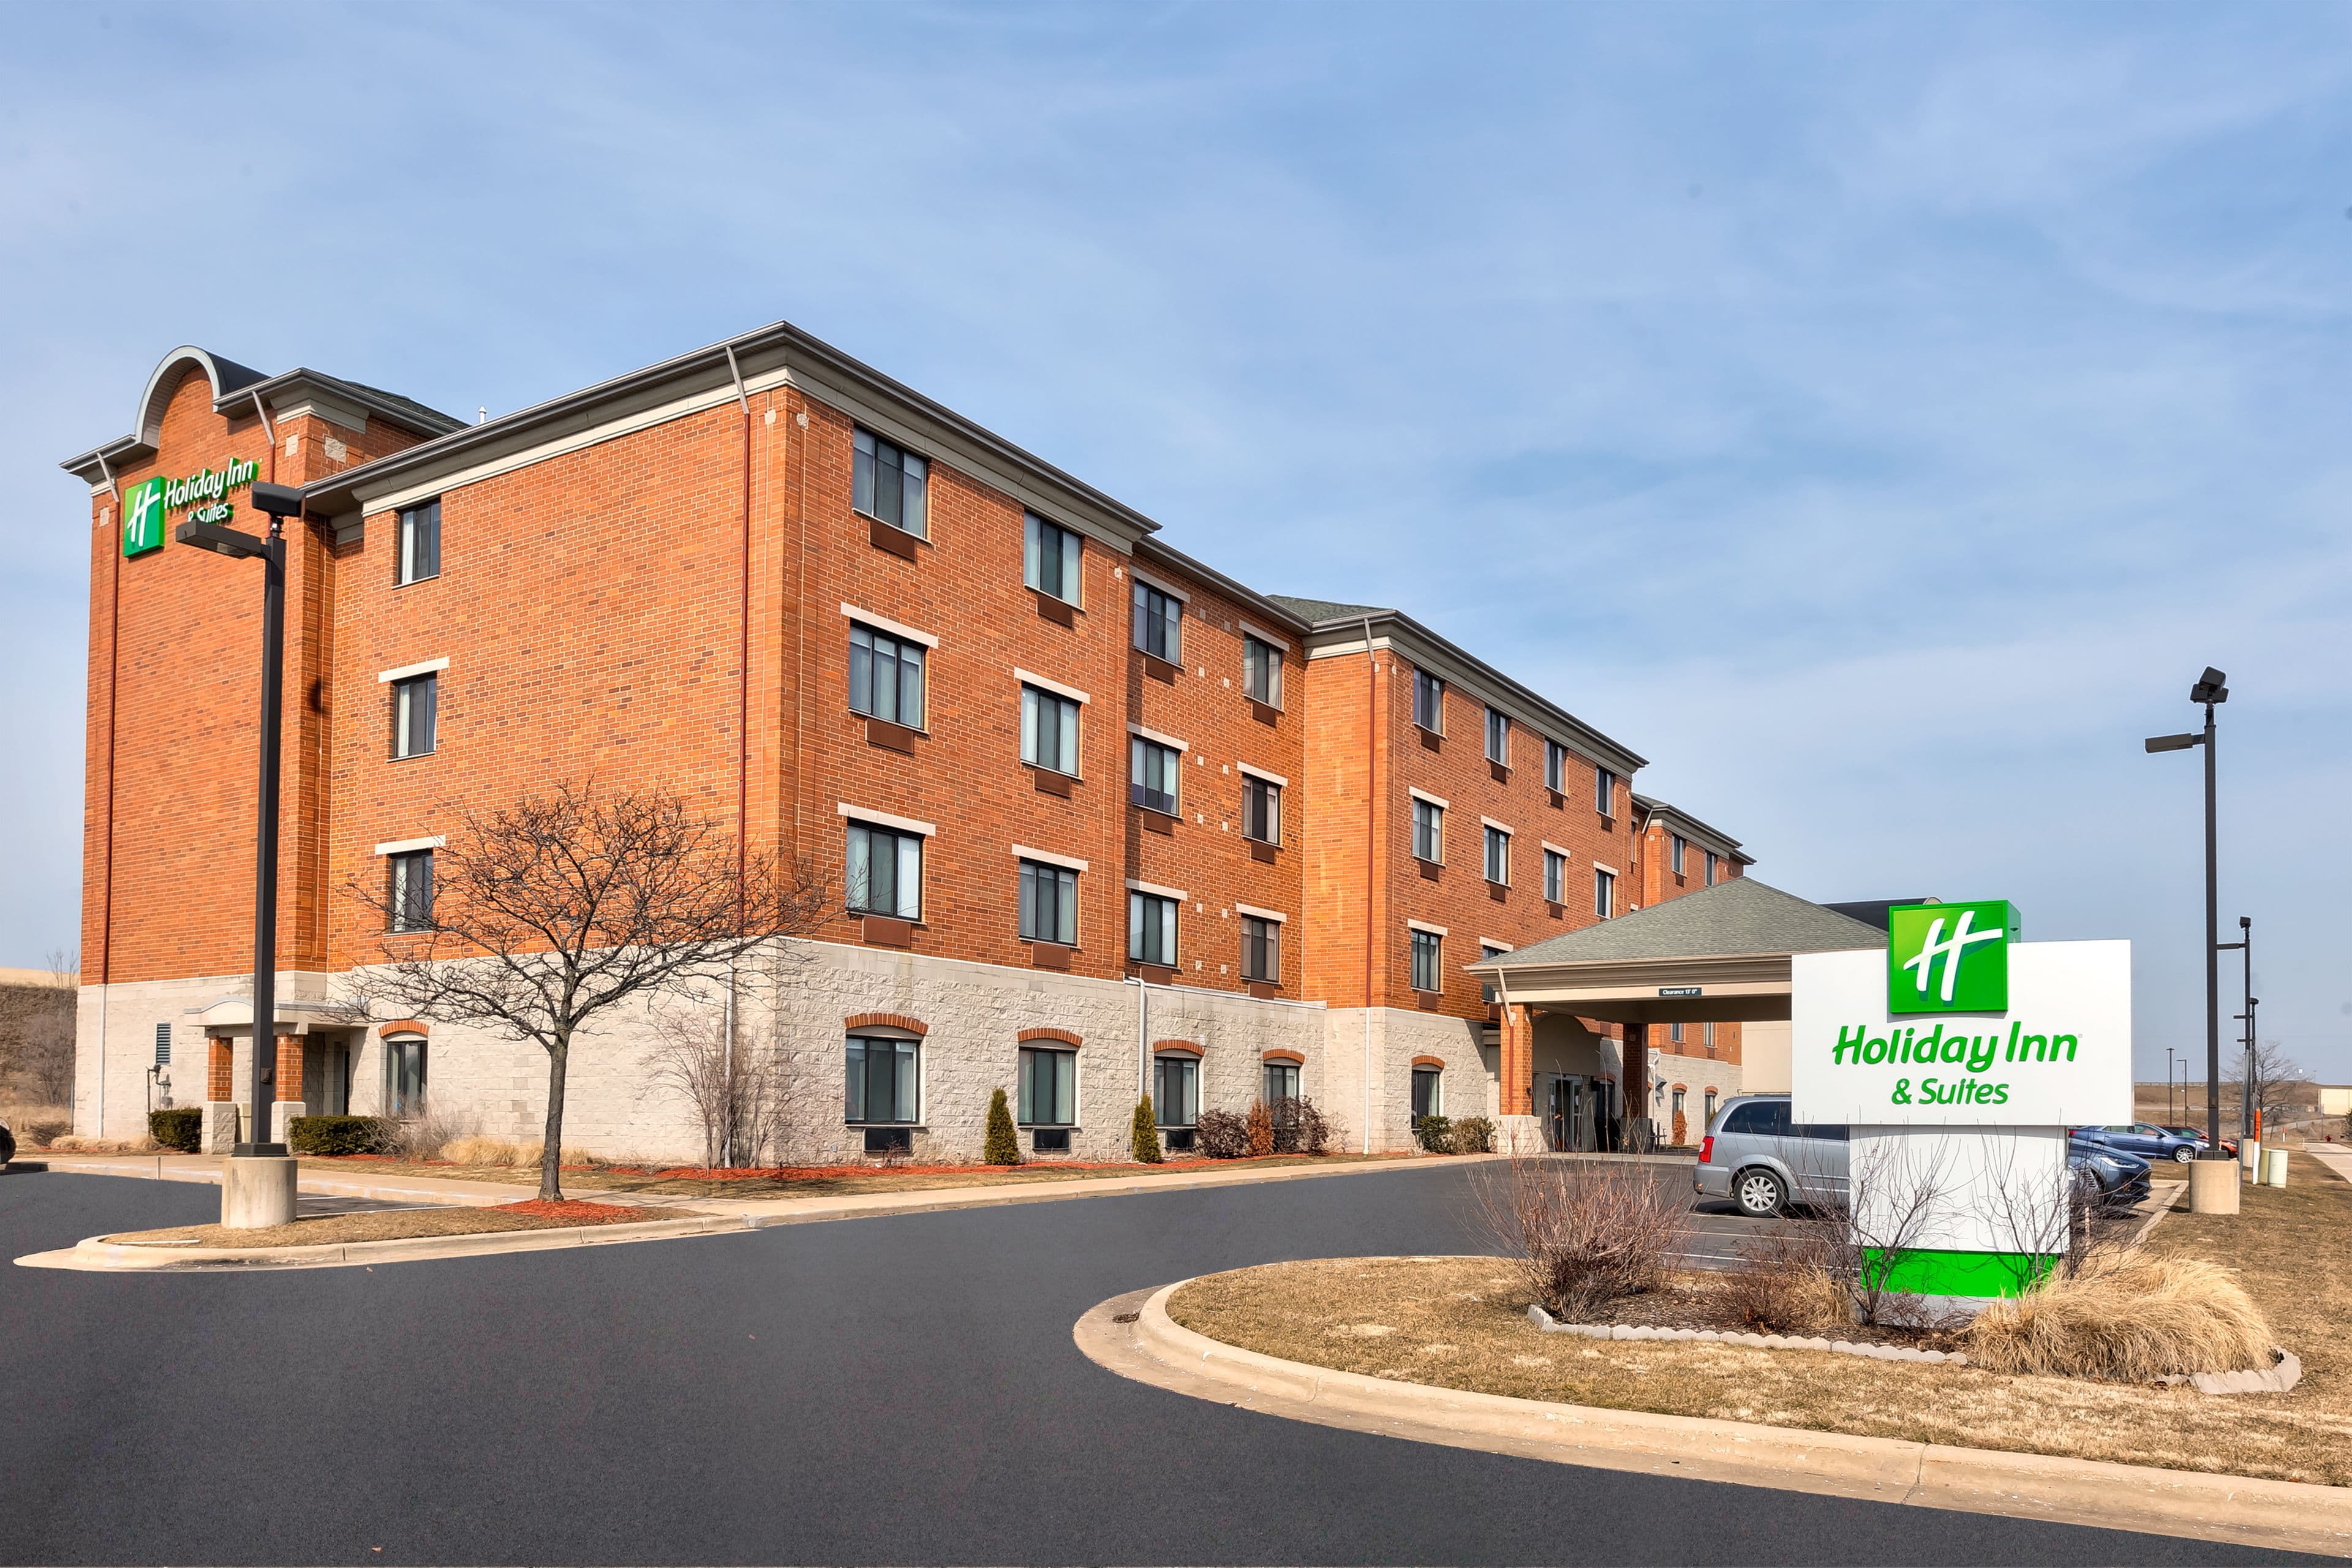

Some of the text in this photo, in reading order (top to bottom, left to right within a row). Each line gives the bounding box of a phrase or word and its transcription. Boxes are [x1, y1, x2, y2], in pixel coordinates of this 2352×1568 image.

[164, 457, 253, 510] Holiday Inn
[197, 502, 228, 522] Suites
[1832, 1021, 2079, 1073] Holiday Inn
[1891, 1078, 2010, 1104] & Suites
